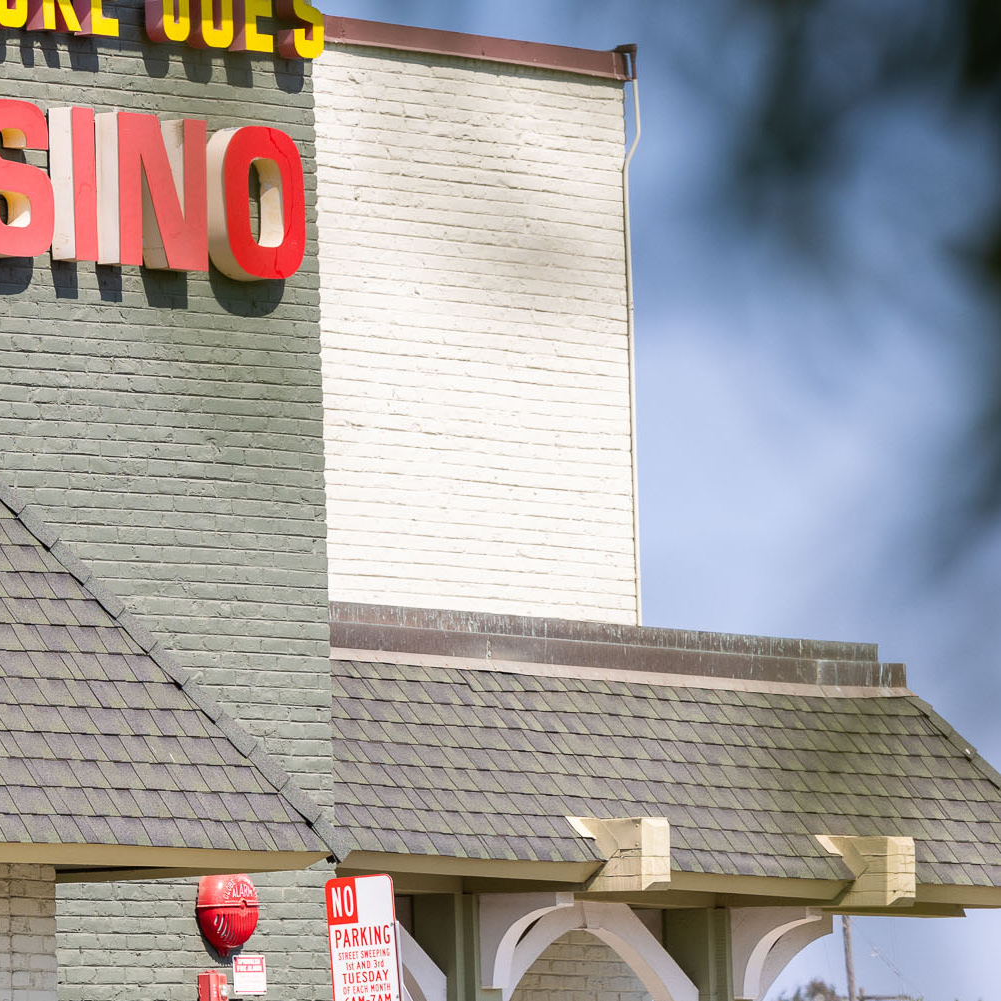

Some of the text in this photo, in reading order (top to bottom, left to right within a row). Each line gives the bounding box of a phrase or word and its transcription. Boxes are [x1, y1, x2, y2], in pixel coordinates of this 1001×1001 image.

[331, 885, 354, 918] NO
[334, 924, 391, 949] PARKING
[338, 948, 391, 961] STREET SWEEPING
[356, 960, 371, 970] AND
[373, 959, 385, 969] 3rd
[342, 969, 389, 985] TUESDAY
[342, 983, 391, 995] OF EACH MONTH
